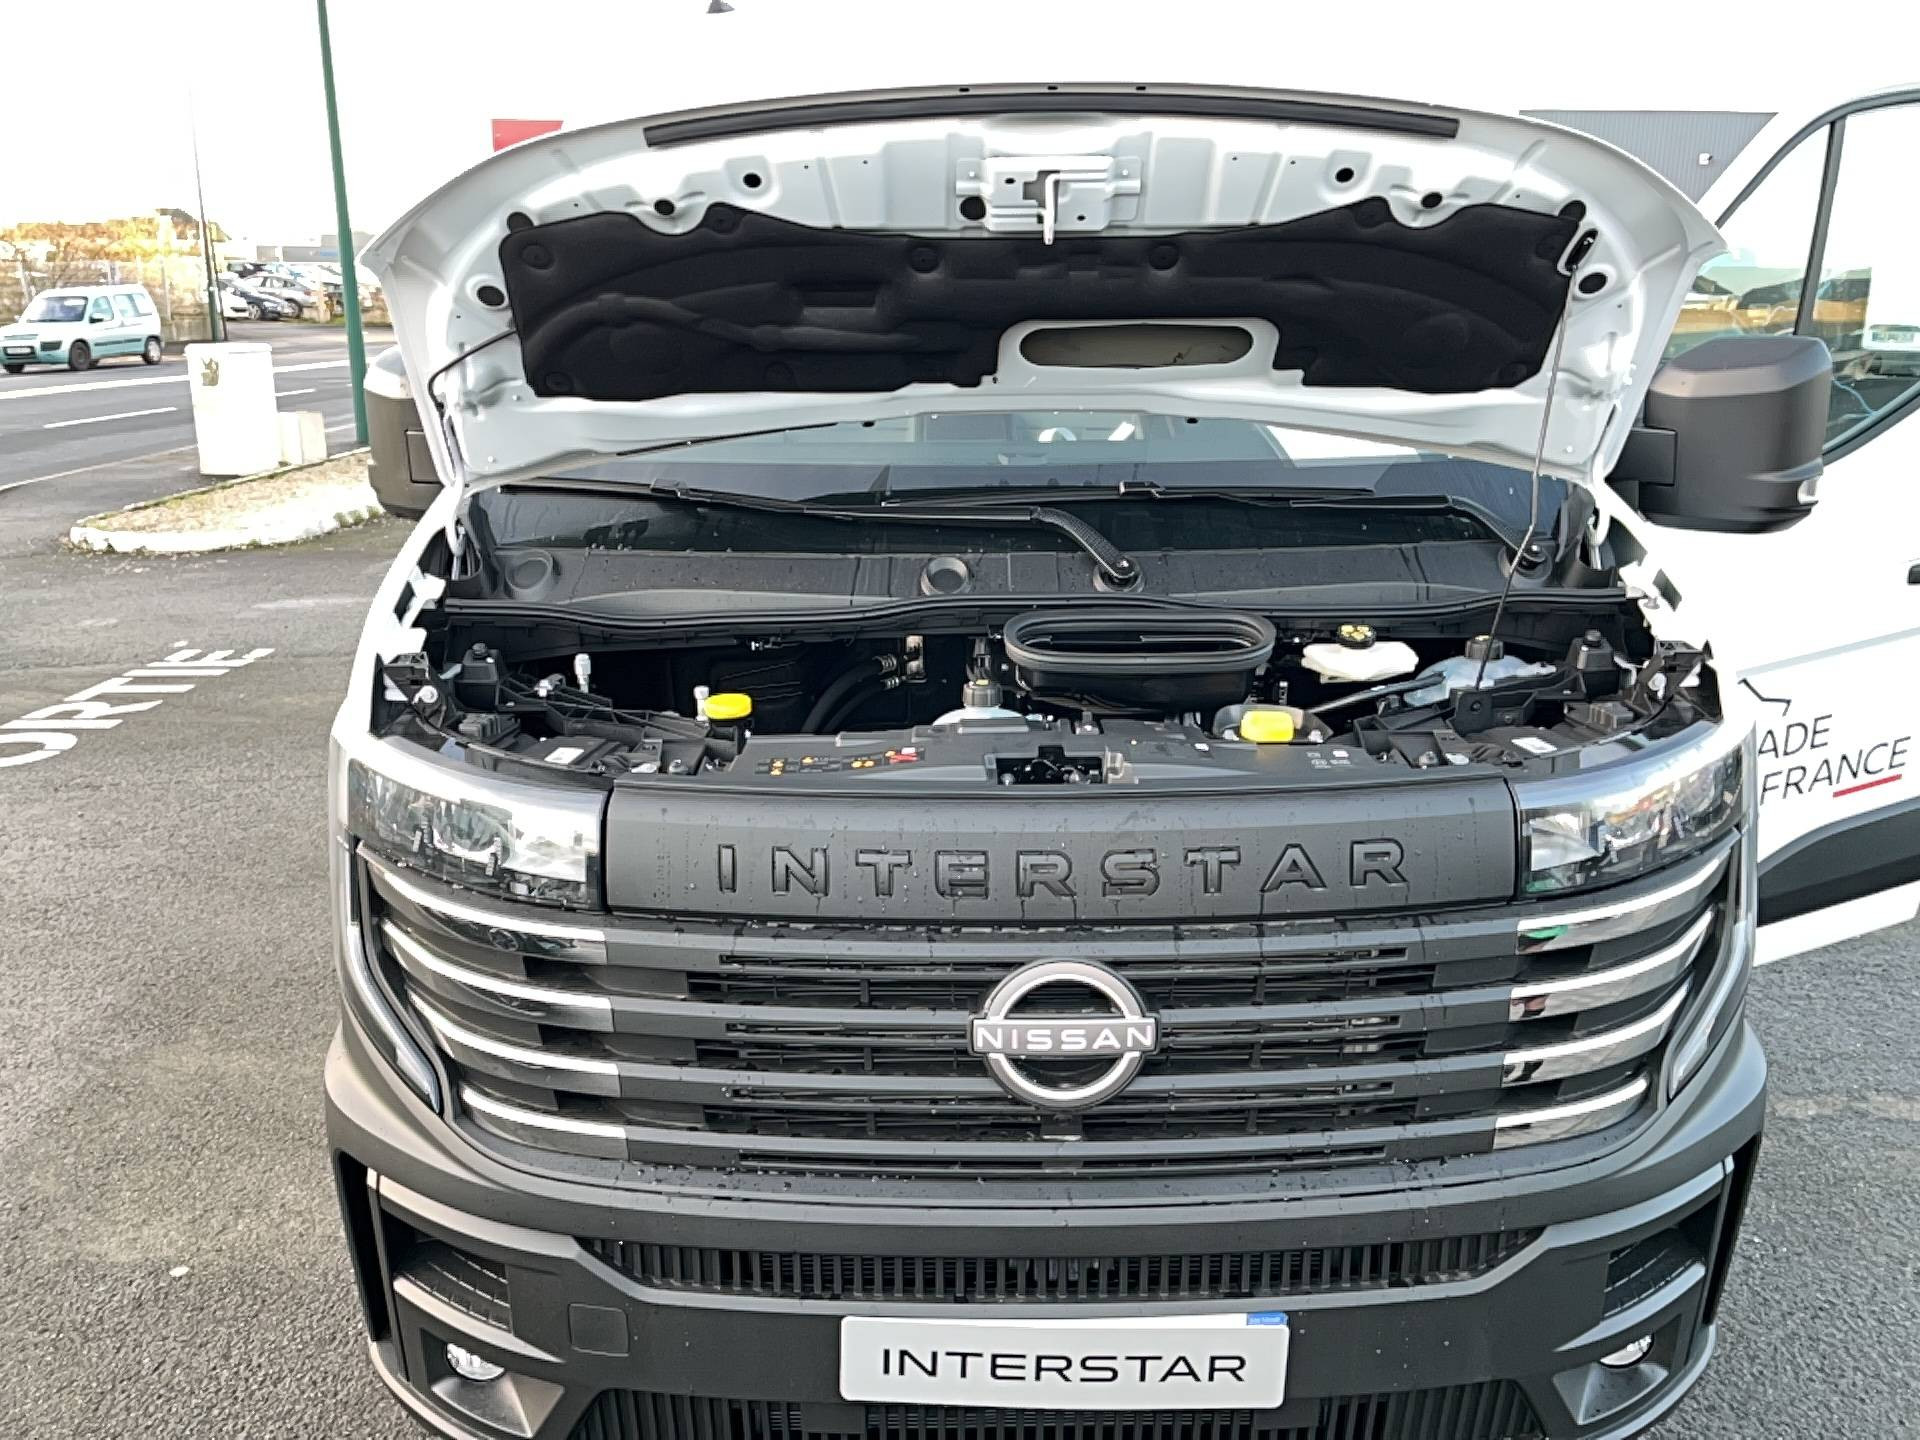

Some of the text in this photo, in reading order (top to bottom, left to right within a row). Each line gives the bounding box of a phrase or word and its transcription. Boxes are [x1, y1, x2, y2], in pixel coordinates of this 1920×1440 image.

[0, 648, 276, 768] ORTIE
[1757, 713, 1833, 759] ADE
[1759, 736, 1911, 806] FRANCE
[717, 839, 1410, 898] INTERSTAR
[976, 1026, 1152, 1050] NISSAN
[882, 1348, 1248, 1383] INTERSTAR
